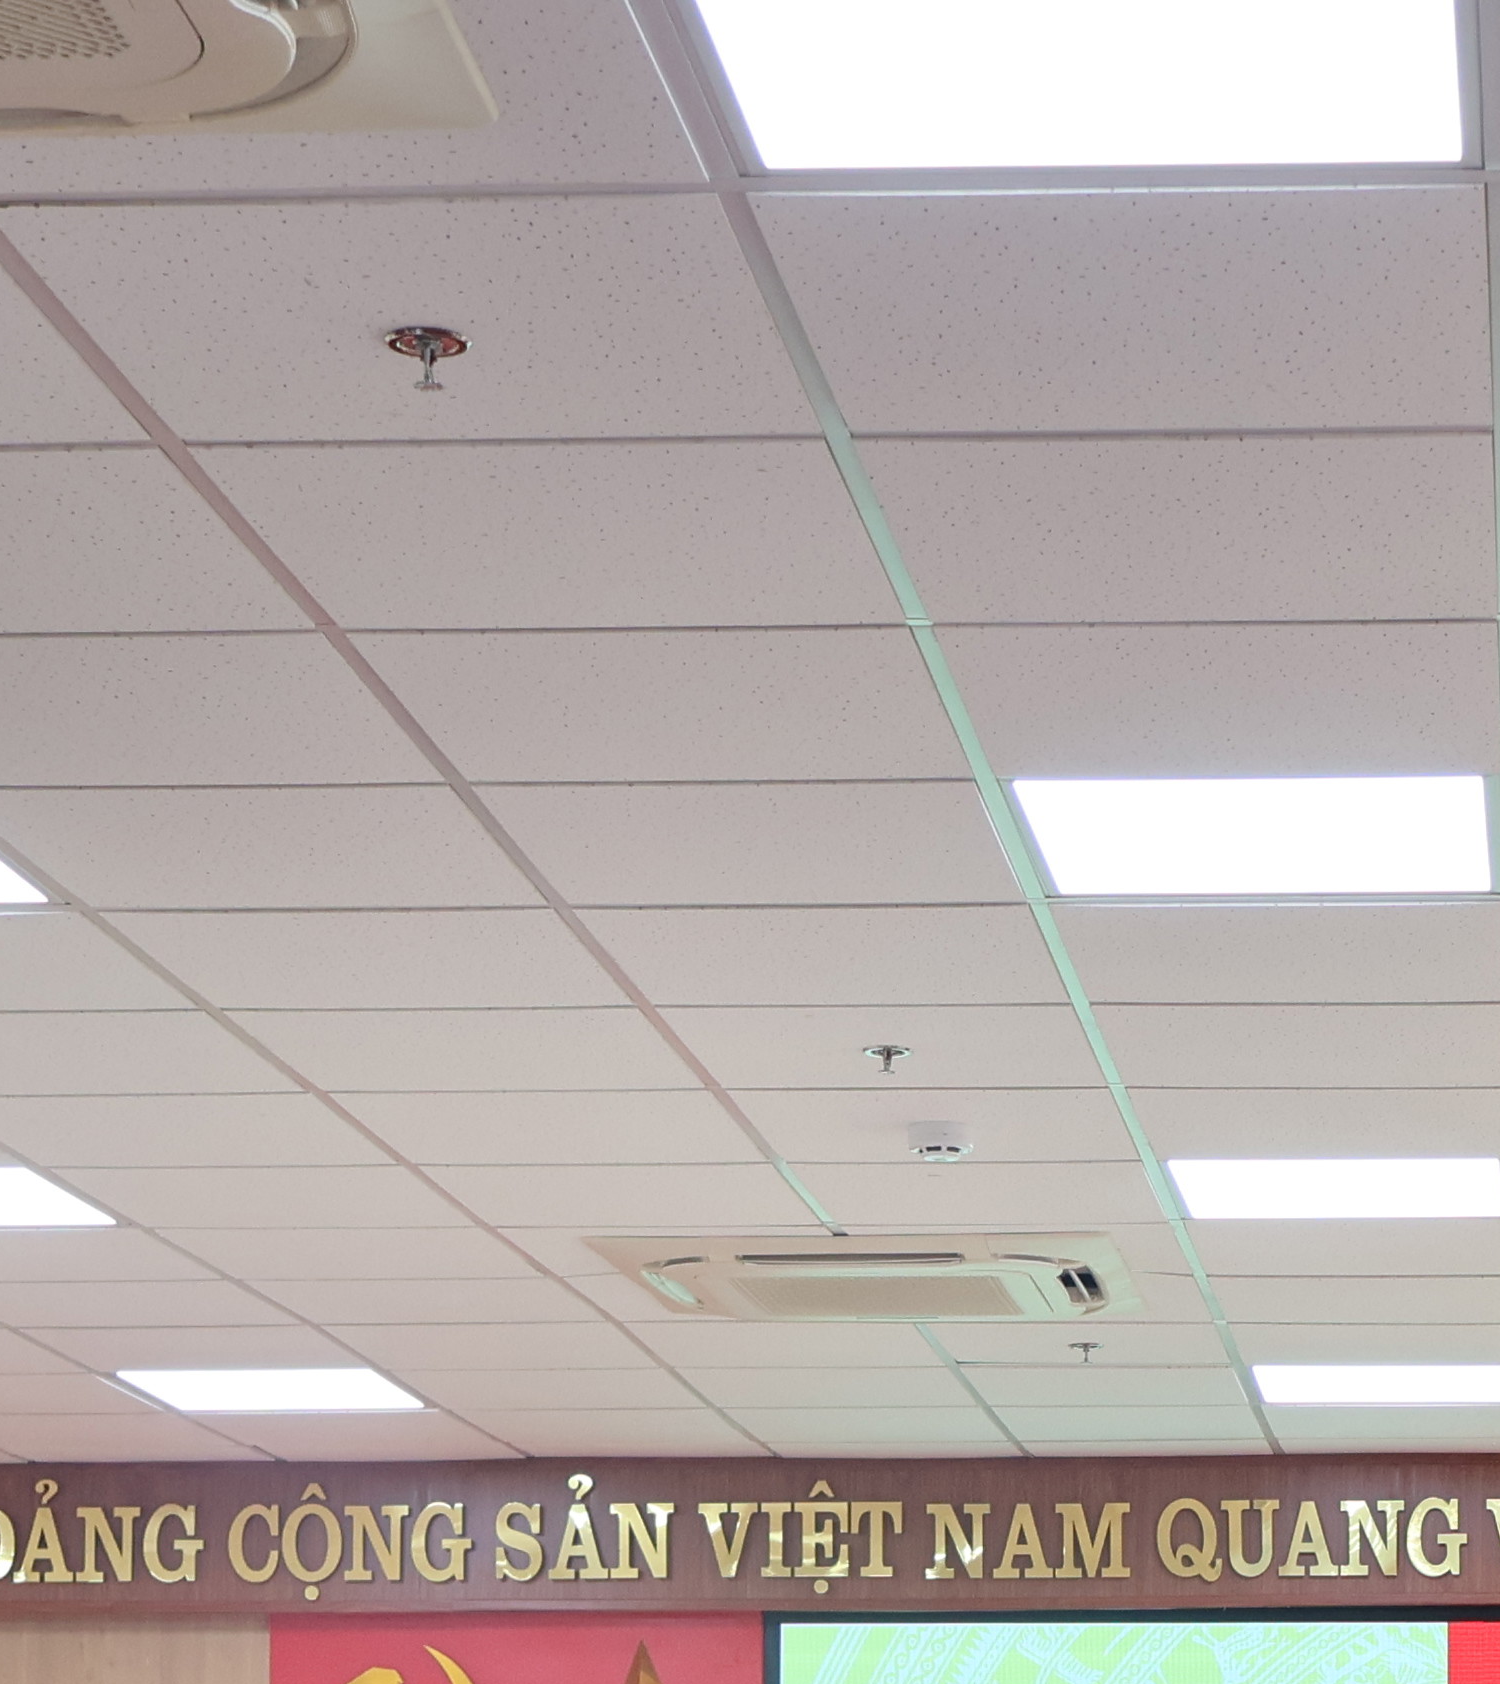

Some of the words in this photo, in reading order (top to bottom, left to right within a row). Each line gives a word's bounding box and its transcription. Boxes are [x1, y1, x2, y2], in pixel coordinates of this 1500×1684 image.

[227, 1483, 475, 1599] CỘNG
[494, 1473, 675, 1582] SẢN
[697, 1480, 902, 1594] VIỆT
[924, 1502, 1131, 1580] NAM
[1157, 1496, 1468, 1582] QUANG
